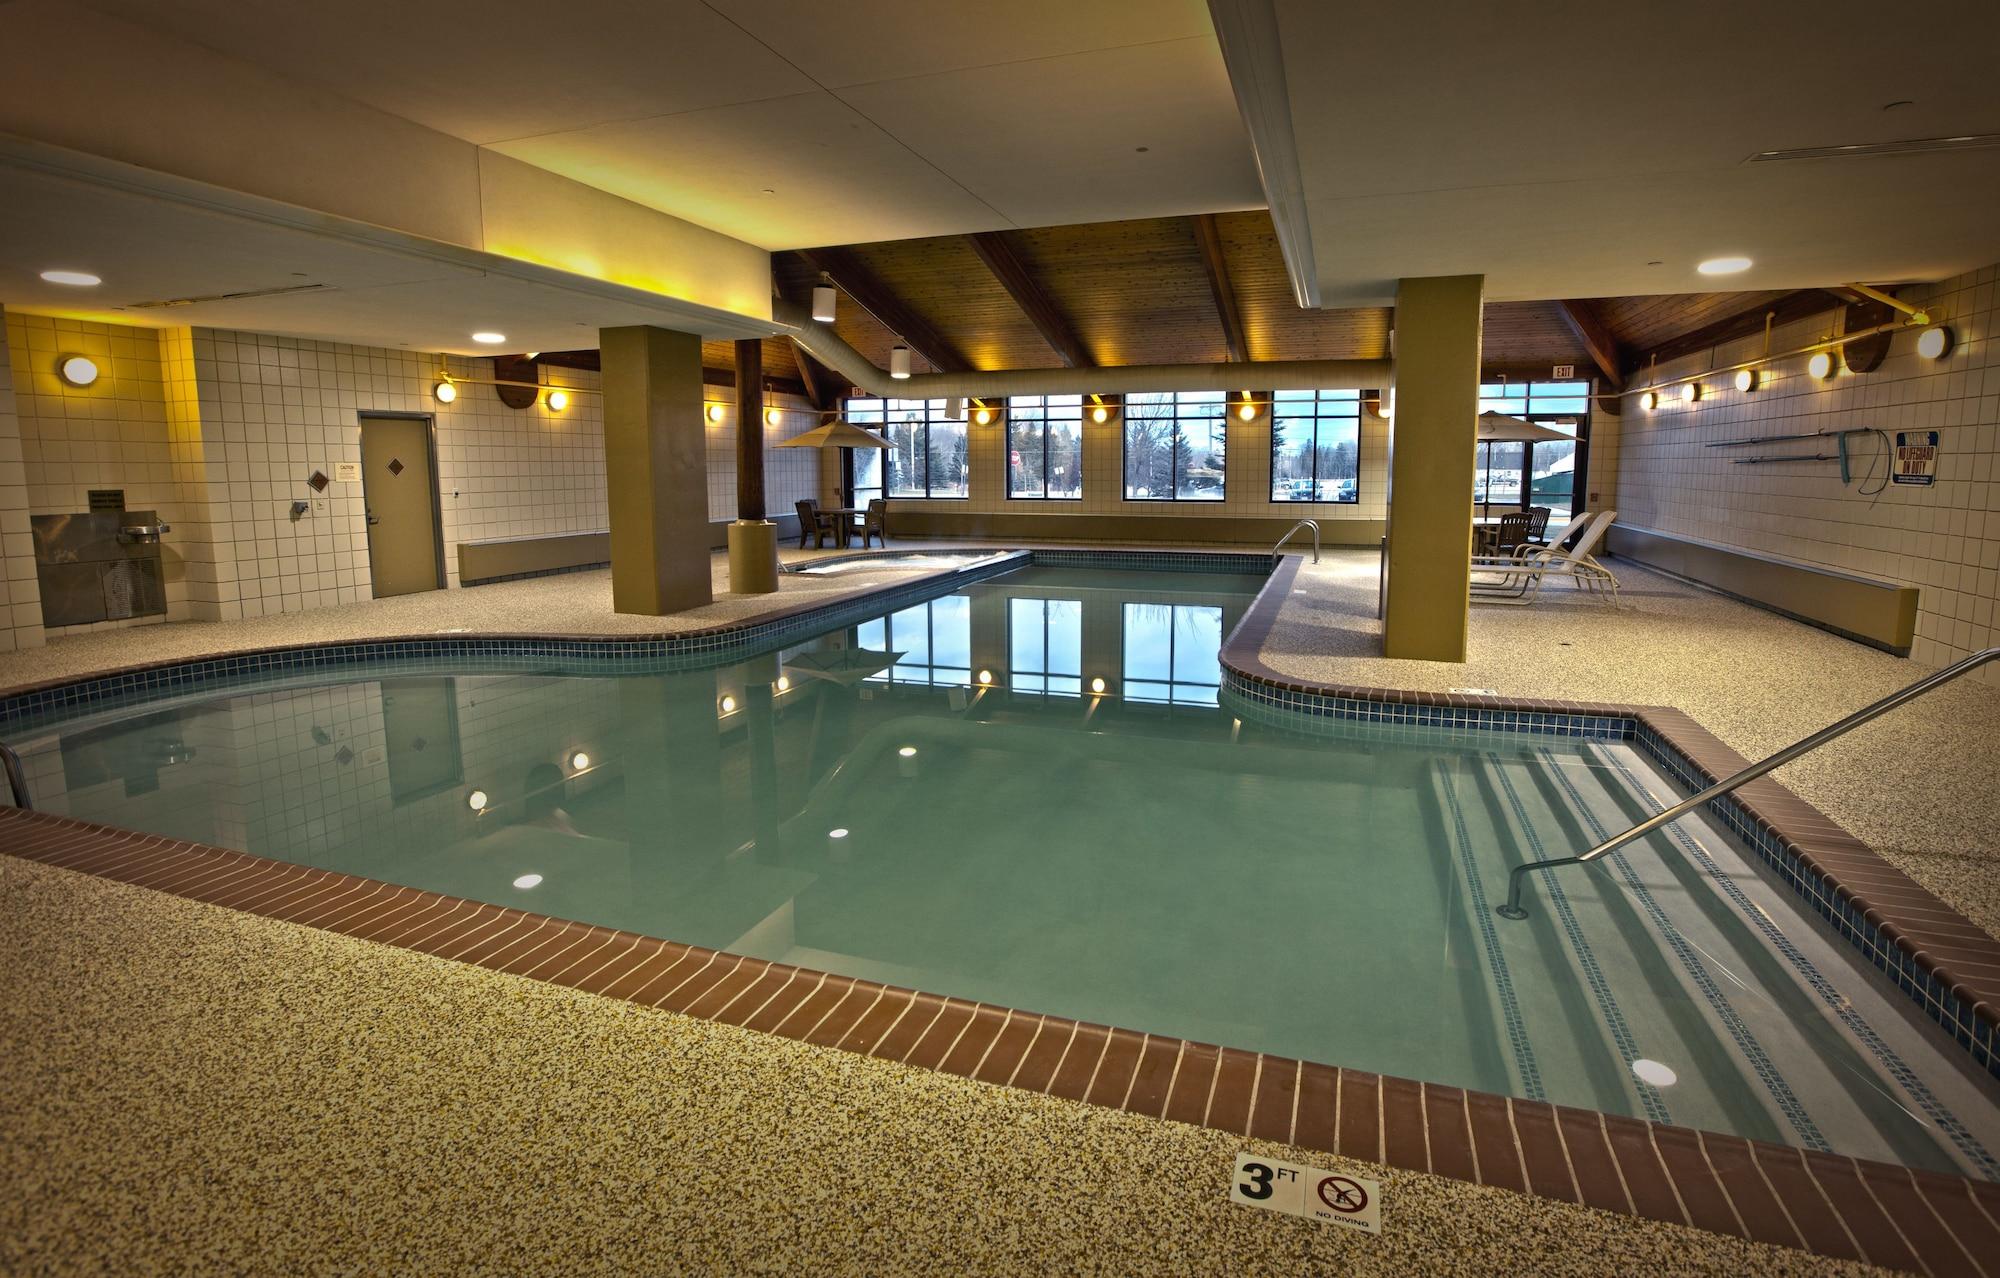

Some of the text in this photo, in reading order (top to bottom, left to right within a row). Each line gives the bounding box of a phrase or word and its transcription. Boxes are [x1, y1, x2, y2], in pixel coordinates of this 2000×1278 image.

[1557, 367, 1570, 377] EXIT
[1898, 446, 1934, 461] NO LIFEGUARD
[1903, 460, 1926, 475] ON DUTY
[1240, 1162, 1300, 1201] 3 FT
[1315, 1210, 1370, 1228] NO DIVING
